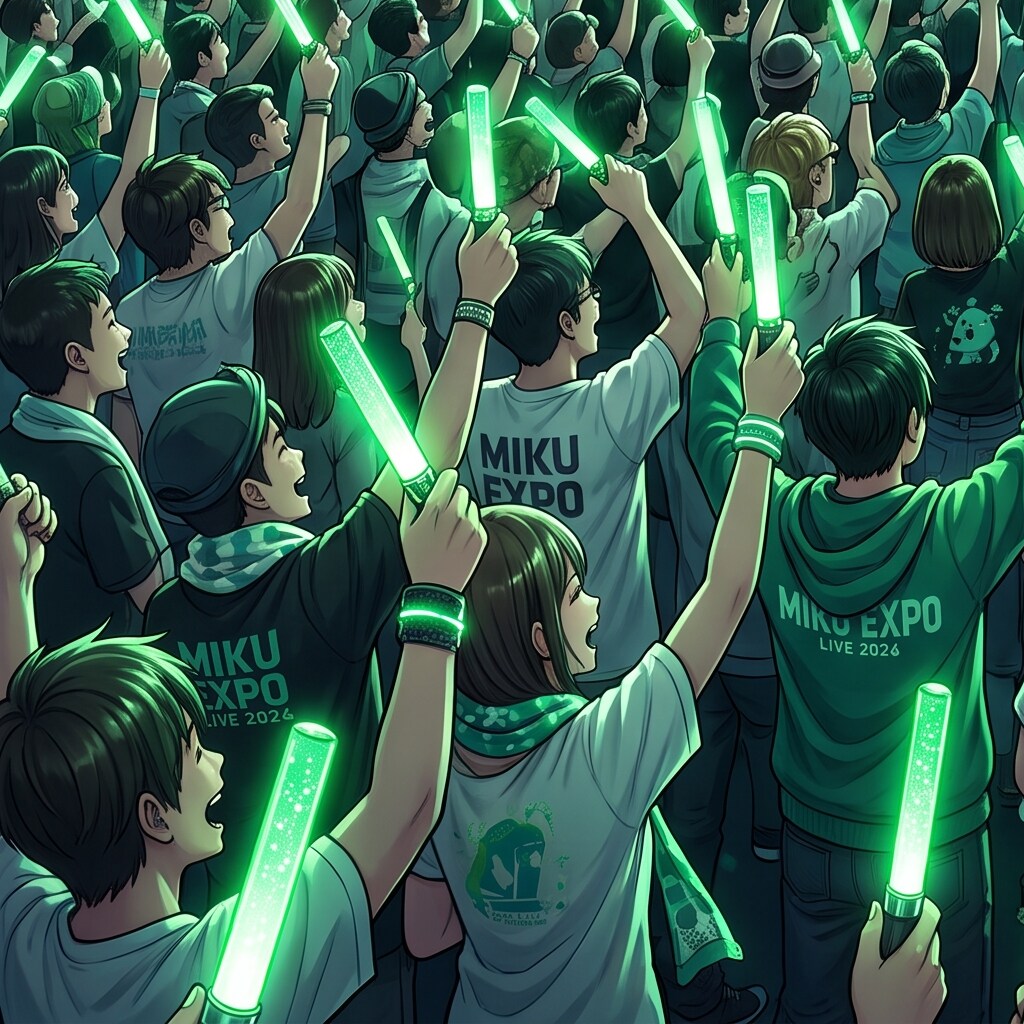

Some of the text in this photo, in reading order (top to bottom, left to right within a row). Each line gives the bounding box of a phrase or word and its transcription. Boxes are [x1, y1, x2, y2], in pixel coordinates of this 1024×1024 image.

[480, 432, 579, 476] MIKU
[177, 628, 281, 677] MIKU
[819, 637, 900, 657] LIVE 2026
